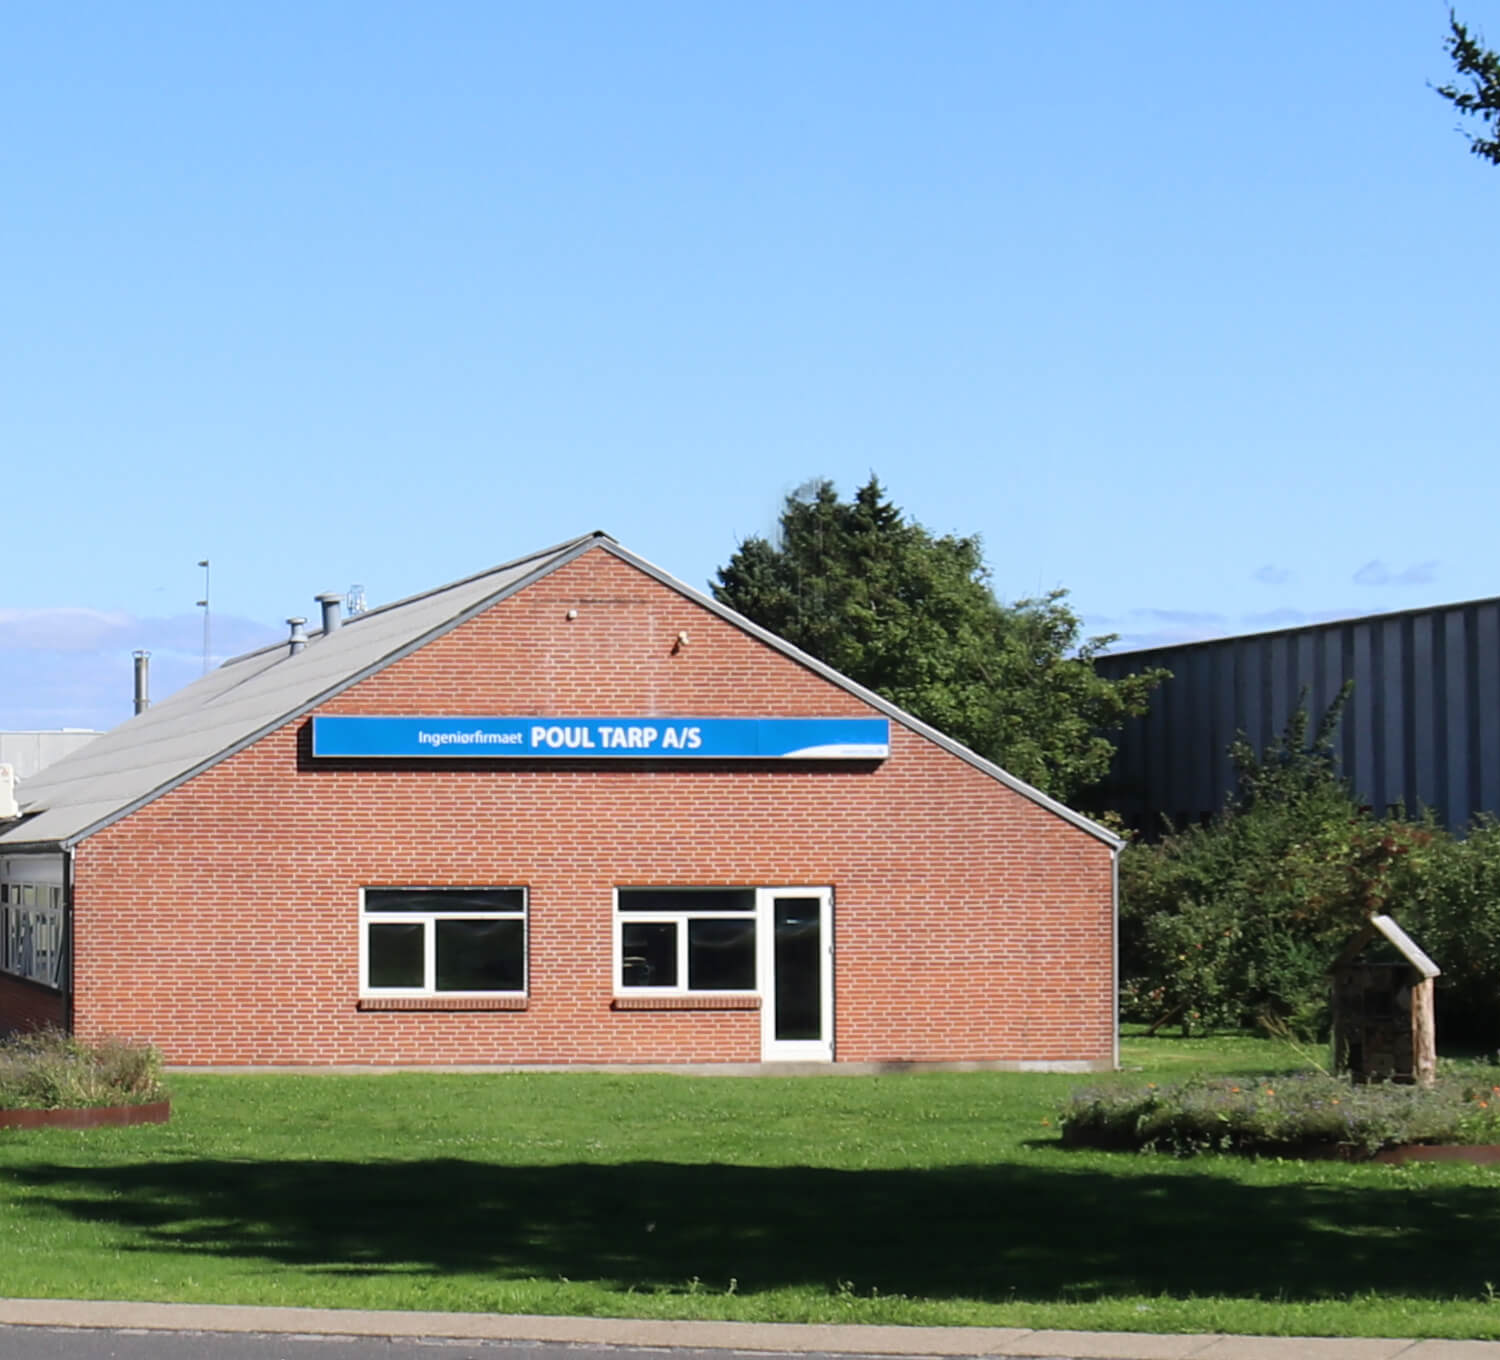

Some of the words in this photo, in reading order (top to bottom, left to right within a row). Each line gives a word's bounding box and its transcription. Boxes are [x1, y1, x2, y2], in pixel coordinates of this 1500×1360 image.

[531, 726, 595, 748] POUL
[598, 727, 658, 748] TARP
[662, 727, 701, 749] A/S
